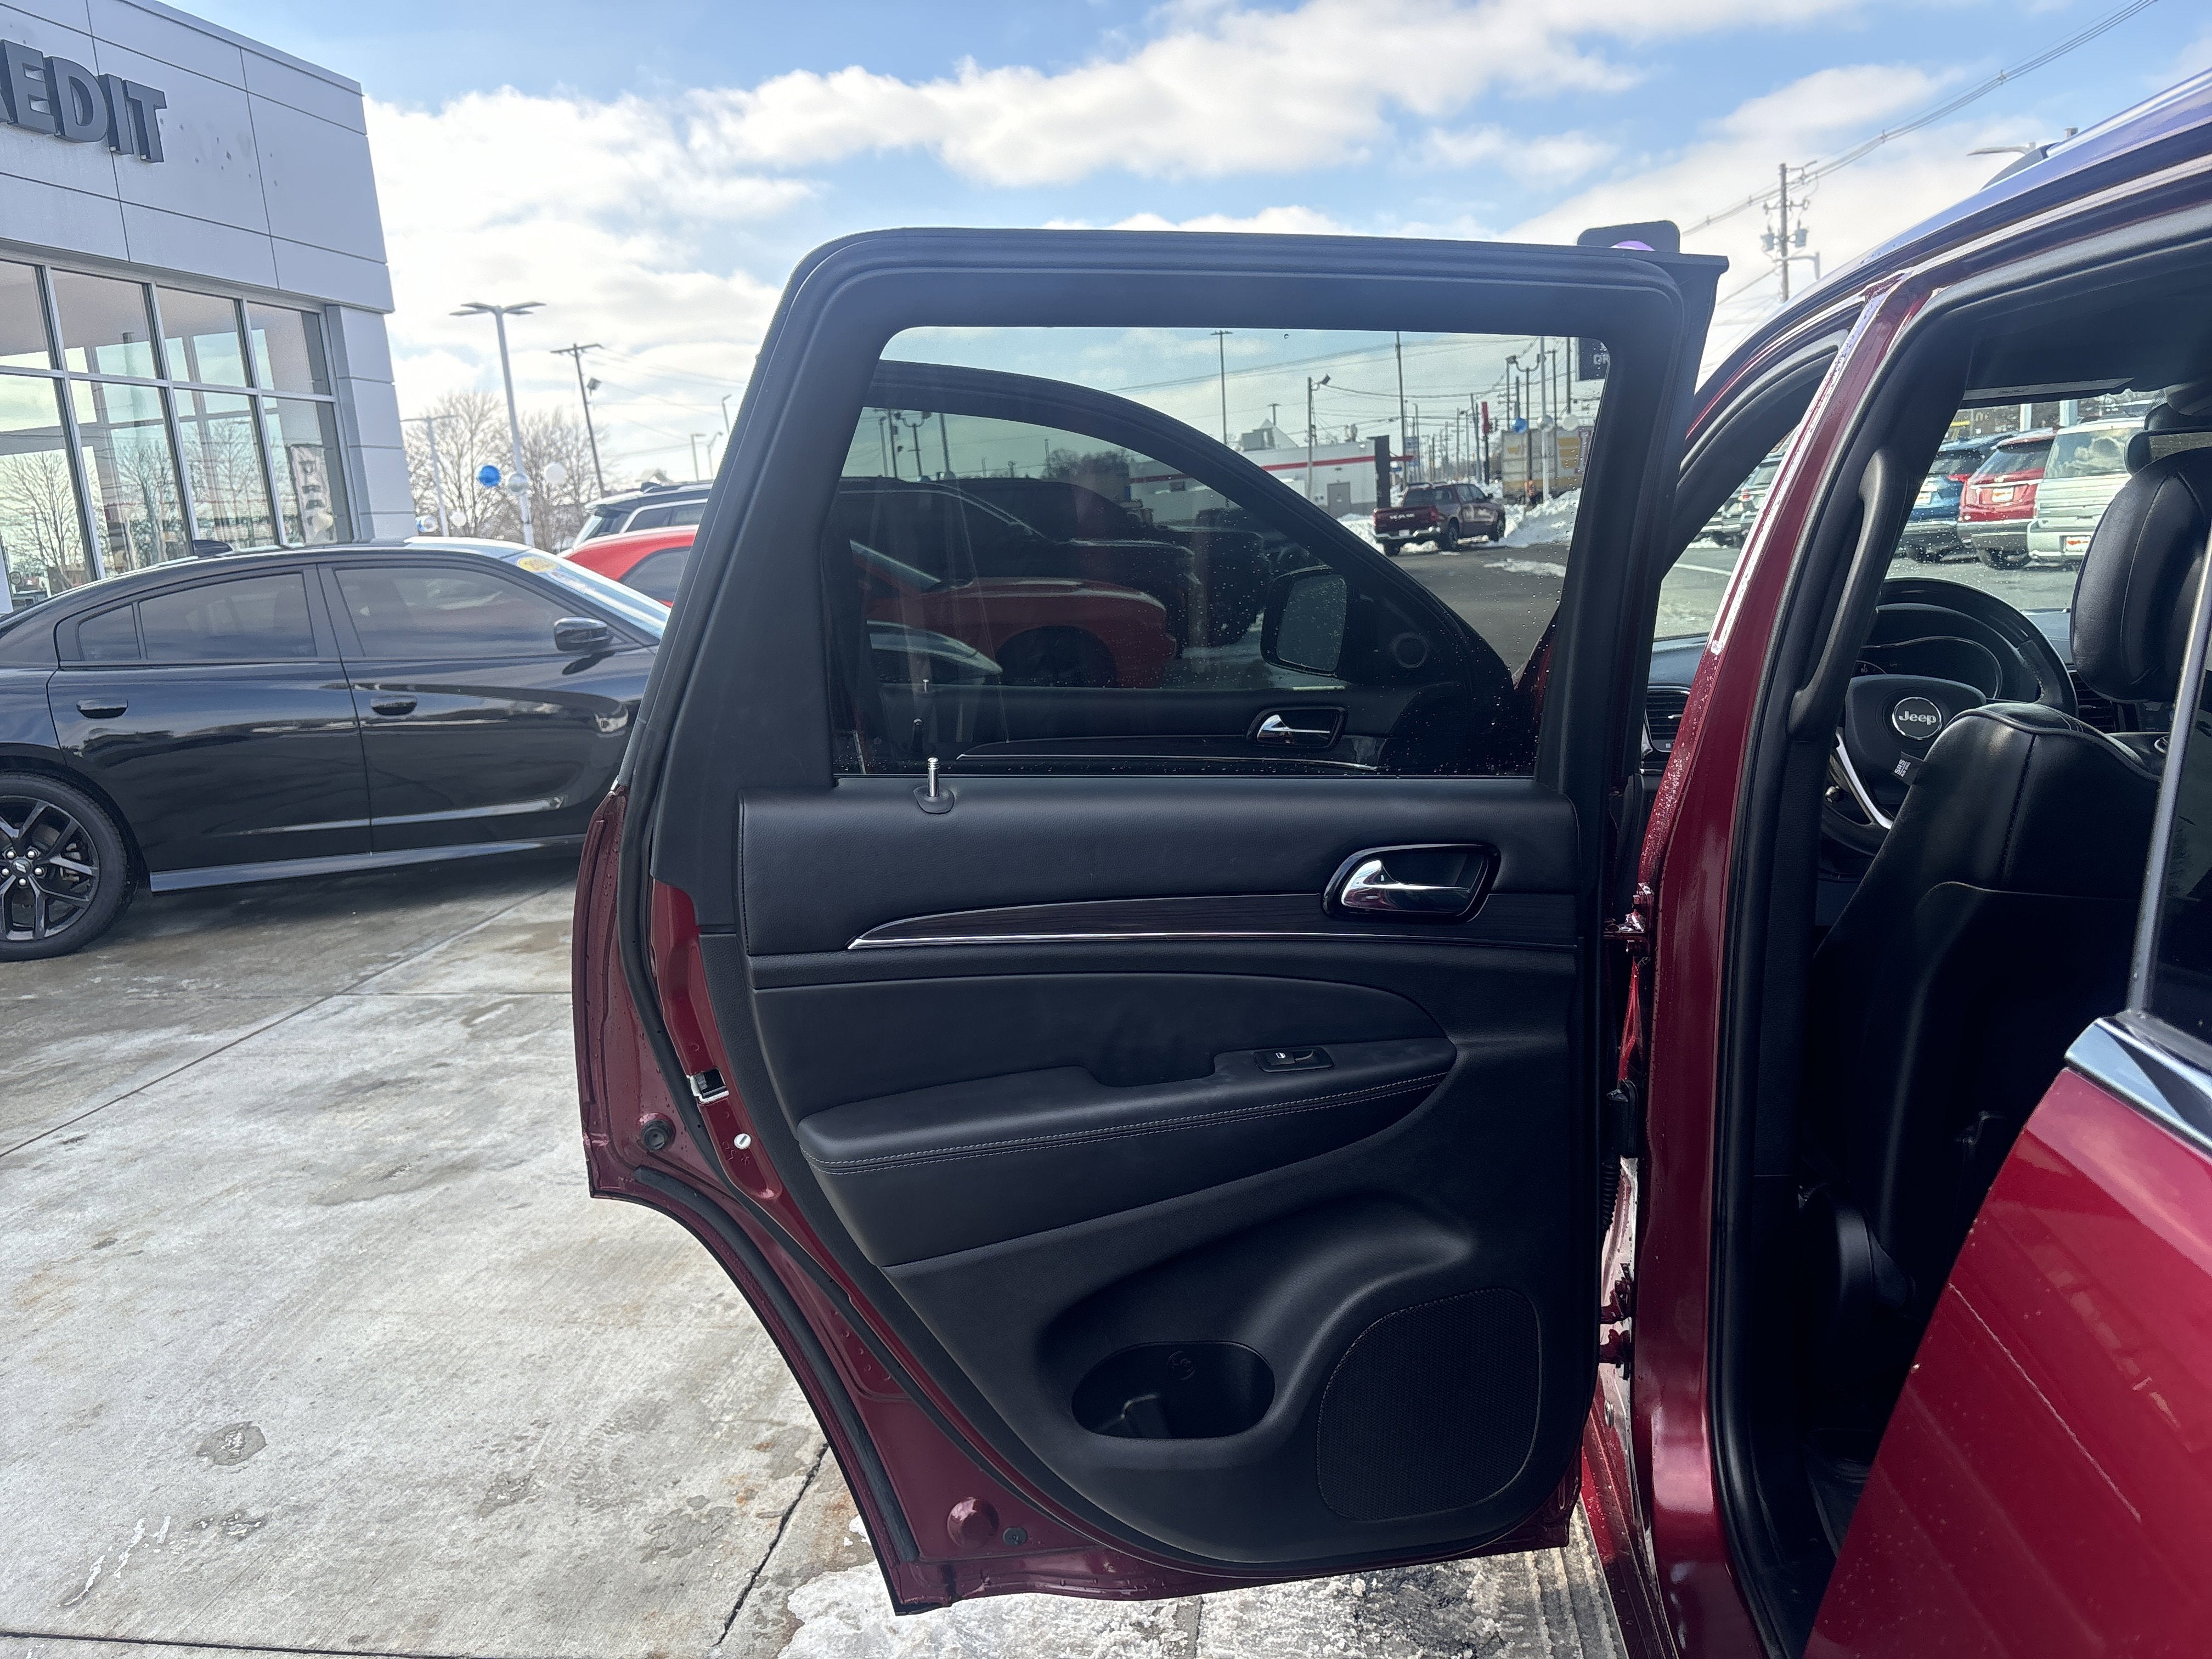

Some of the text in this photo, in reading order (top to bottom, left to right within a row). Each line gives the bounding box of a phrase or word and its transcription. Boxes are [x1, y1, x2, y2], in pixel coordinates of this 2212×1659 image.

[0, 40, 167, 163] EDIT
[1899, 710, 1937, 725] Jeep
[1894, 759, 1905, 775] SRS
